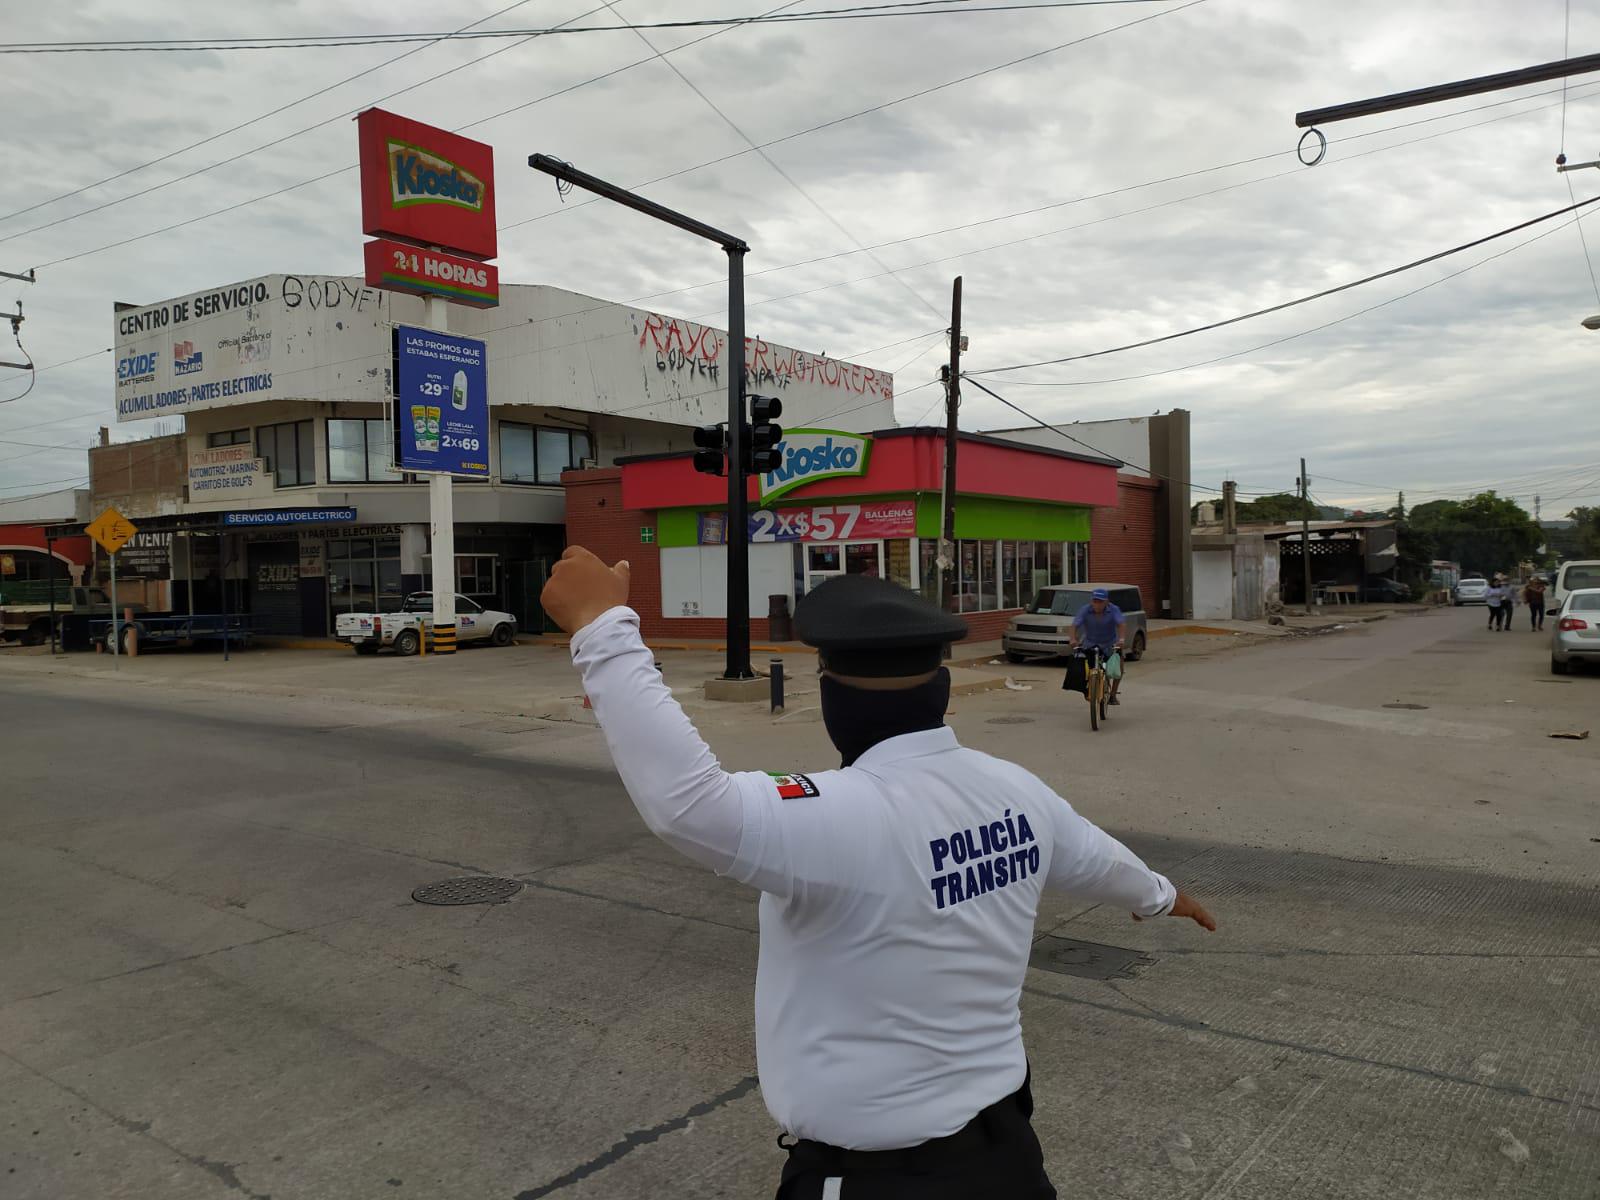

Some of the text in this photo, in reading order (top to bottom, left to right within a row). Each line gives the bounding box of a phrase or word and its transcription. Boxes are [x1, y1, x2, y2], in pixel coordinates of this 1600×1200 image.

[396, 153, 479, 204] Kiosko
[424, 257, 487, 288] HORAS
[119, 306, 169, 336] CENTRO
[173, 301, 189, 324] DE
[406, 337, 480, 358] LAS PROMOS QUE
[406, 348, 480, 366] ESTABAS ESPERANDO
[117, 352, 157, 379] EXIDE
[119, 388, 187, 415] ACUMULADORES
[191, 382, 221, 401] PARTES
[222, 373, 273, 397] ELECTRICAS
[229, 461, 259, 474] MARINAS
[766, 437, 857, 488] Kiosko
[193, 478, 222, 490] CARRITOS
[222, 478, 231, 488] DE
[228, 510, 352, 523] SERVICIO AUTOELECTRICO
[864, 509, 914, 519] BALLENAS
[308, 528, 339, 539] PARTES
[256, 565, 298, 582] EXIDE
[929, 808, 1035, 872] POLICÍA
[931, 844, 1040, 909] TRANSITO
